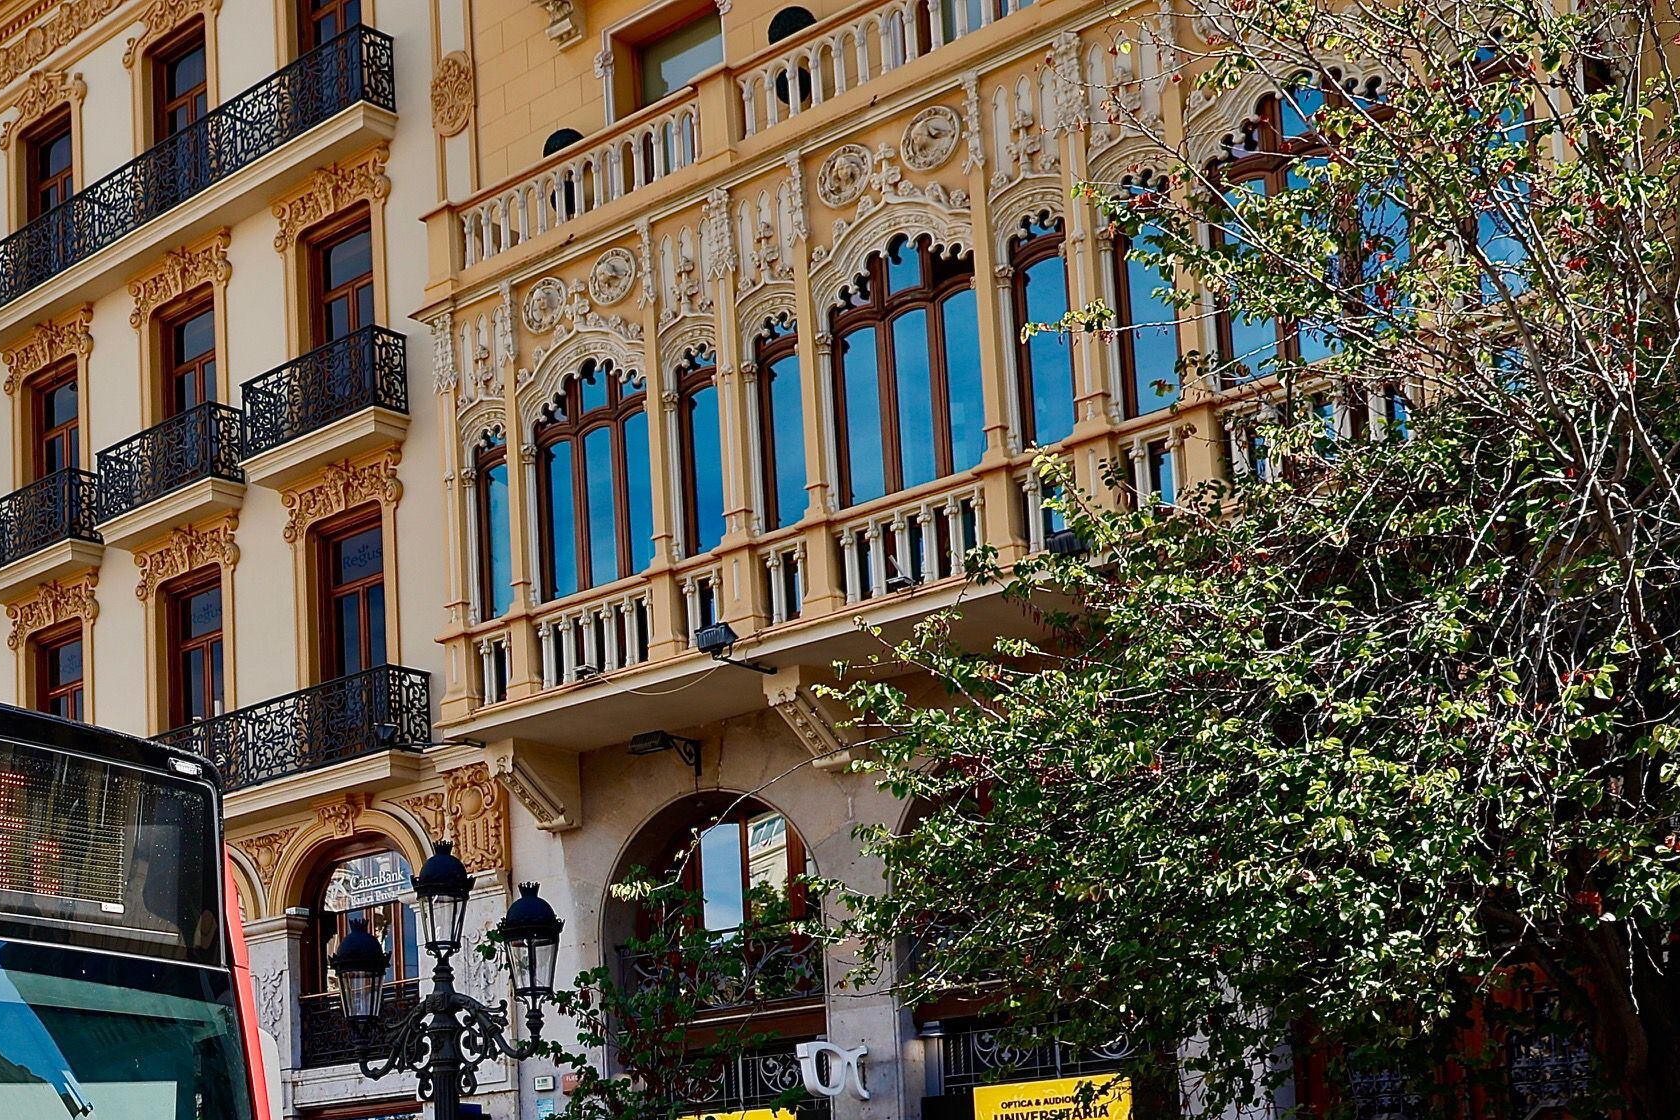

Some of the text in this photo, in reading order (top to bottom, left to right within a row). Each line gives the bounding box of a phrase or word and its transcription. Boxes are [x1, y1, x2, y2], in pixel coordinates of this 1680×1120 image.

[349, 867, 406, 890] CaixaBank
[1001, 1100, 1033, 1110] OPTICA
[1034, 1098, 1042, 1106] &
